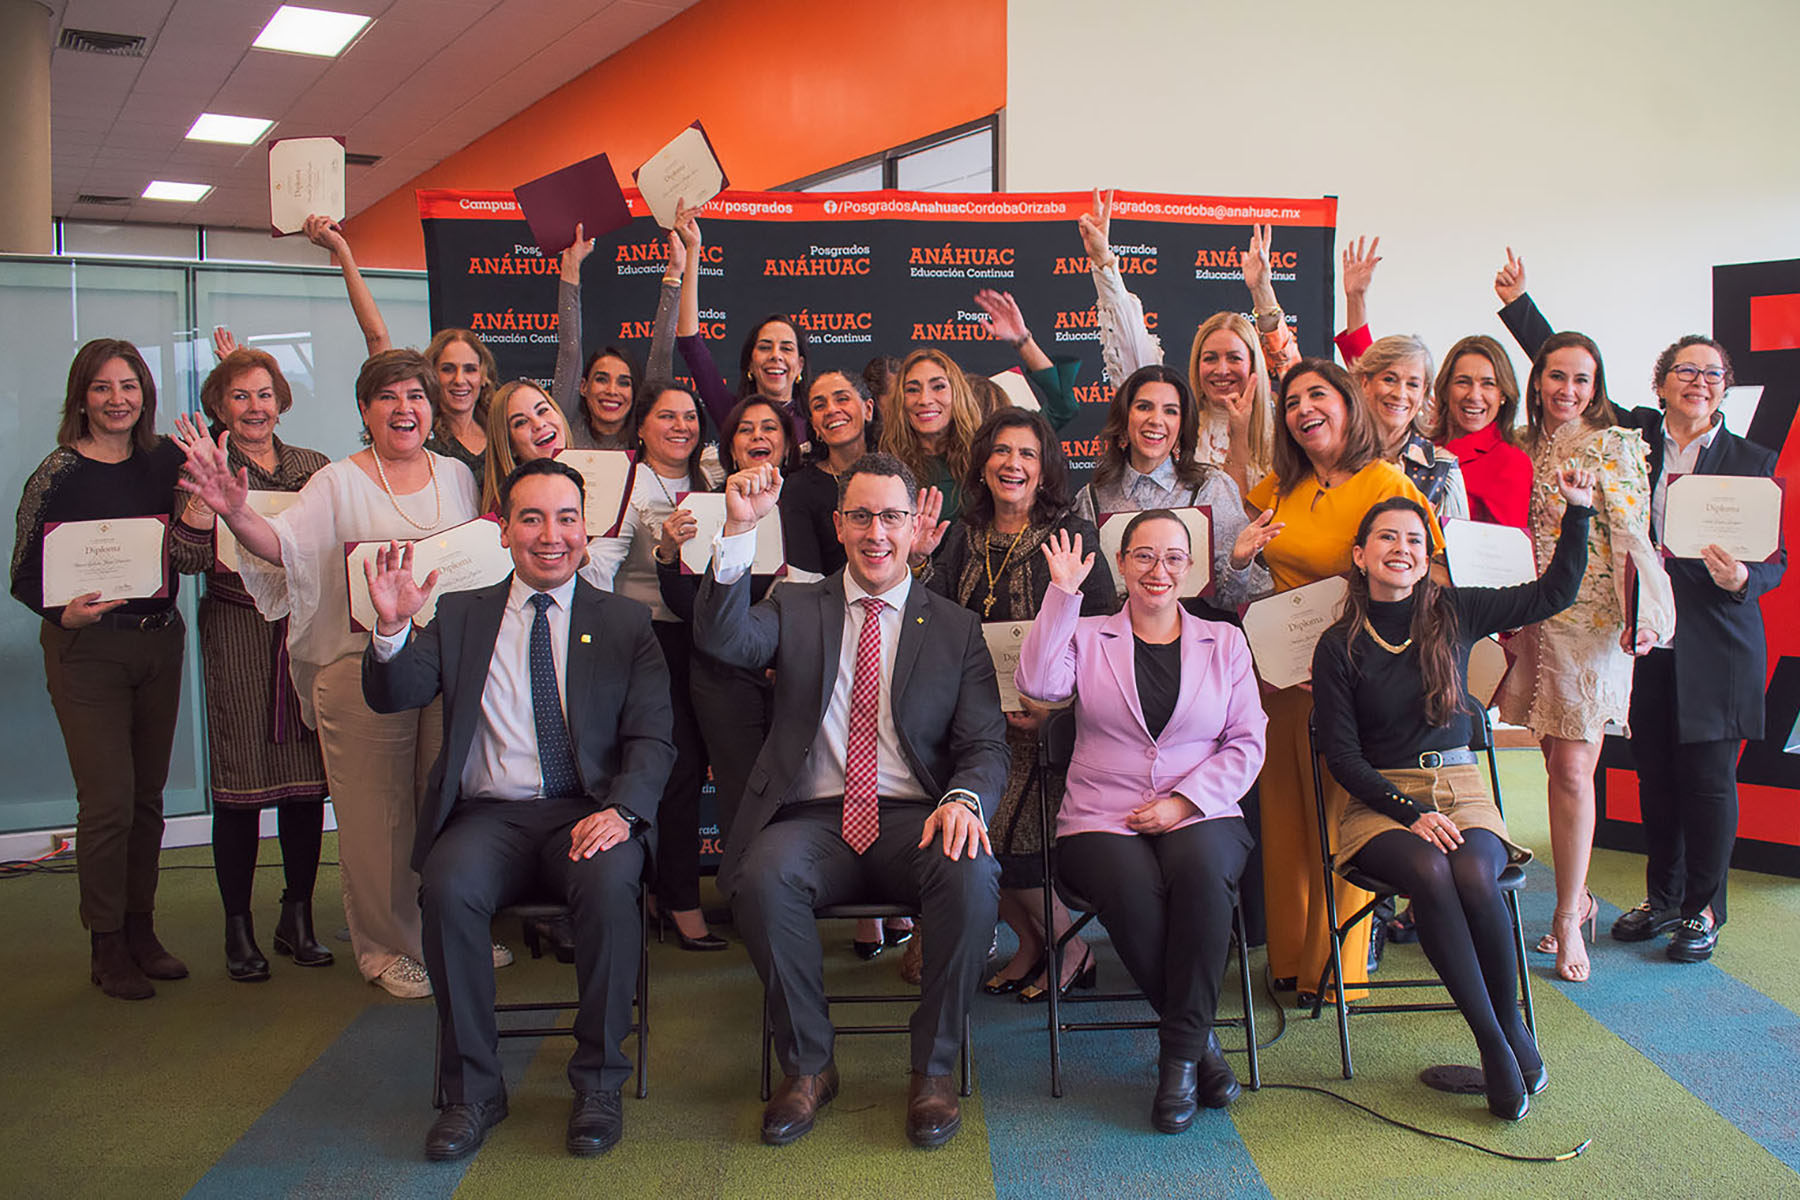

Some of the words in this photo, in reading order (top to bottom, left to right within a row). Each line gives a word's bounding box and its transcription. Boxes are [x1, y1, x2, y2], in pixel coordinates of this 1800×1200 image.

[459, 199, 516, 213] Campus
[1100, 201, 1300, 220] sgrados.cordoba@anahuac.mx
[810, 244, 870, 258] Posgrados
[909, 243, 1015, 265] ANÁHUAC
[1108, 244, 1158, 256] osgrados
[1195, 246, 1297, 268] ANÁAC
[468, 253, 561, 275] ANÁHUA
[617, 264, 668, 276] Educació
[763, 254, 871, 277] ANÁHUAC
[910, 267, 965, 278] Educación
[966, 268, 1014, 279] Continua
[1196, 269, 1245, 280] Educació
[470, 308, 560, 330] ANÁHUA
[1054, 306, 1158, 329] ANÁC
[475, 333, 528, 344] ducación
[529, 334, 560, 344] Conti
[619, 322, 726, 340] ANAC
[823, 333, 872, 344] Continua
[911, 319, 1003, 341] ANÁHU
